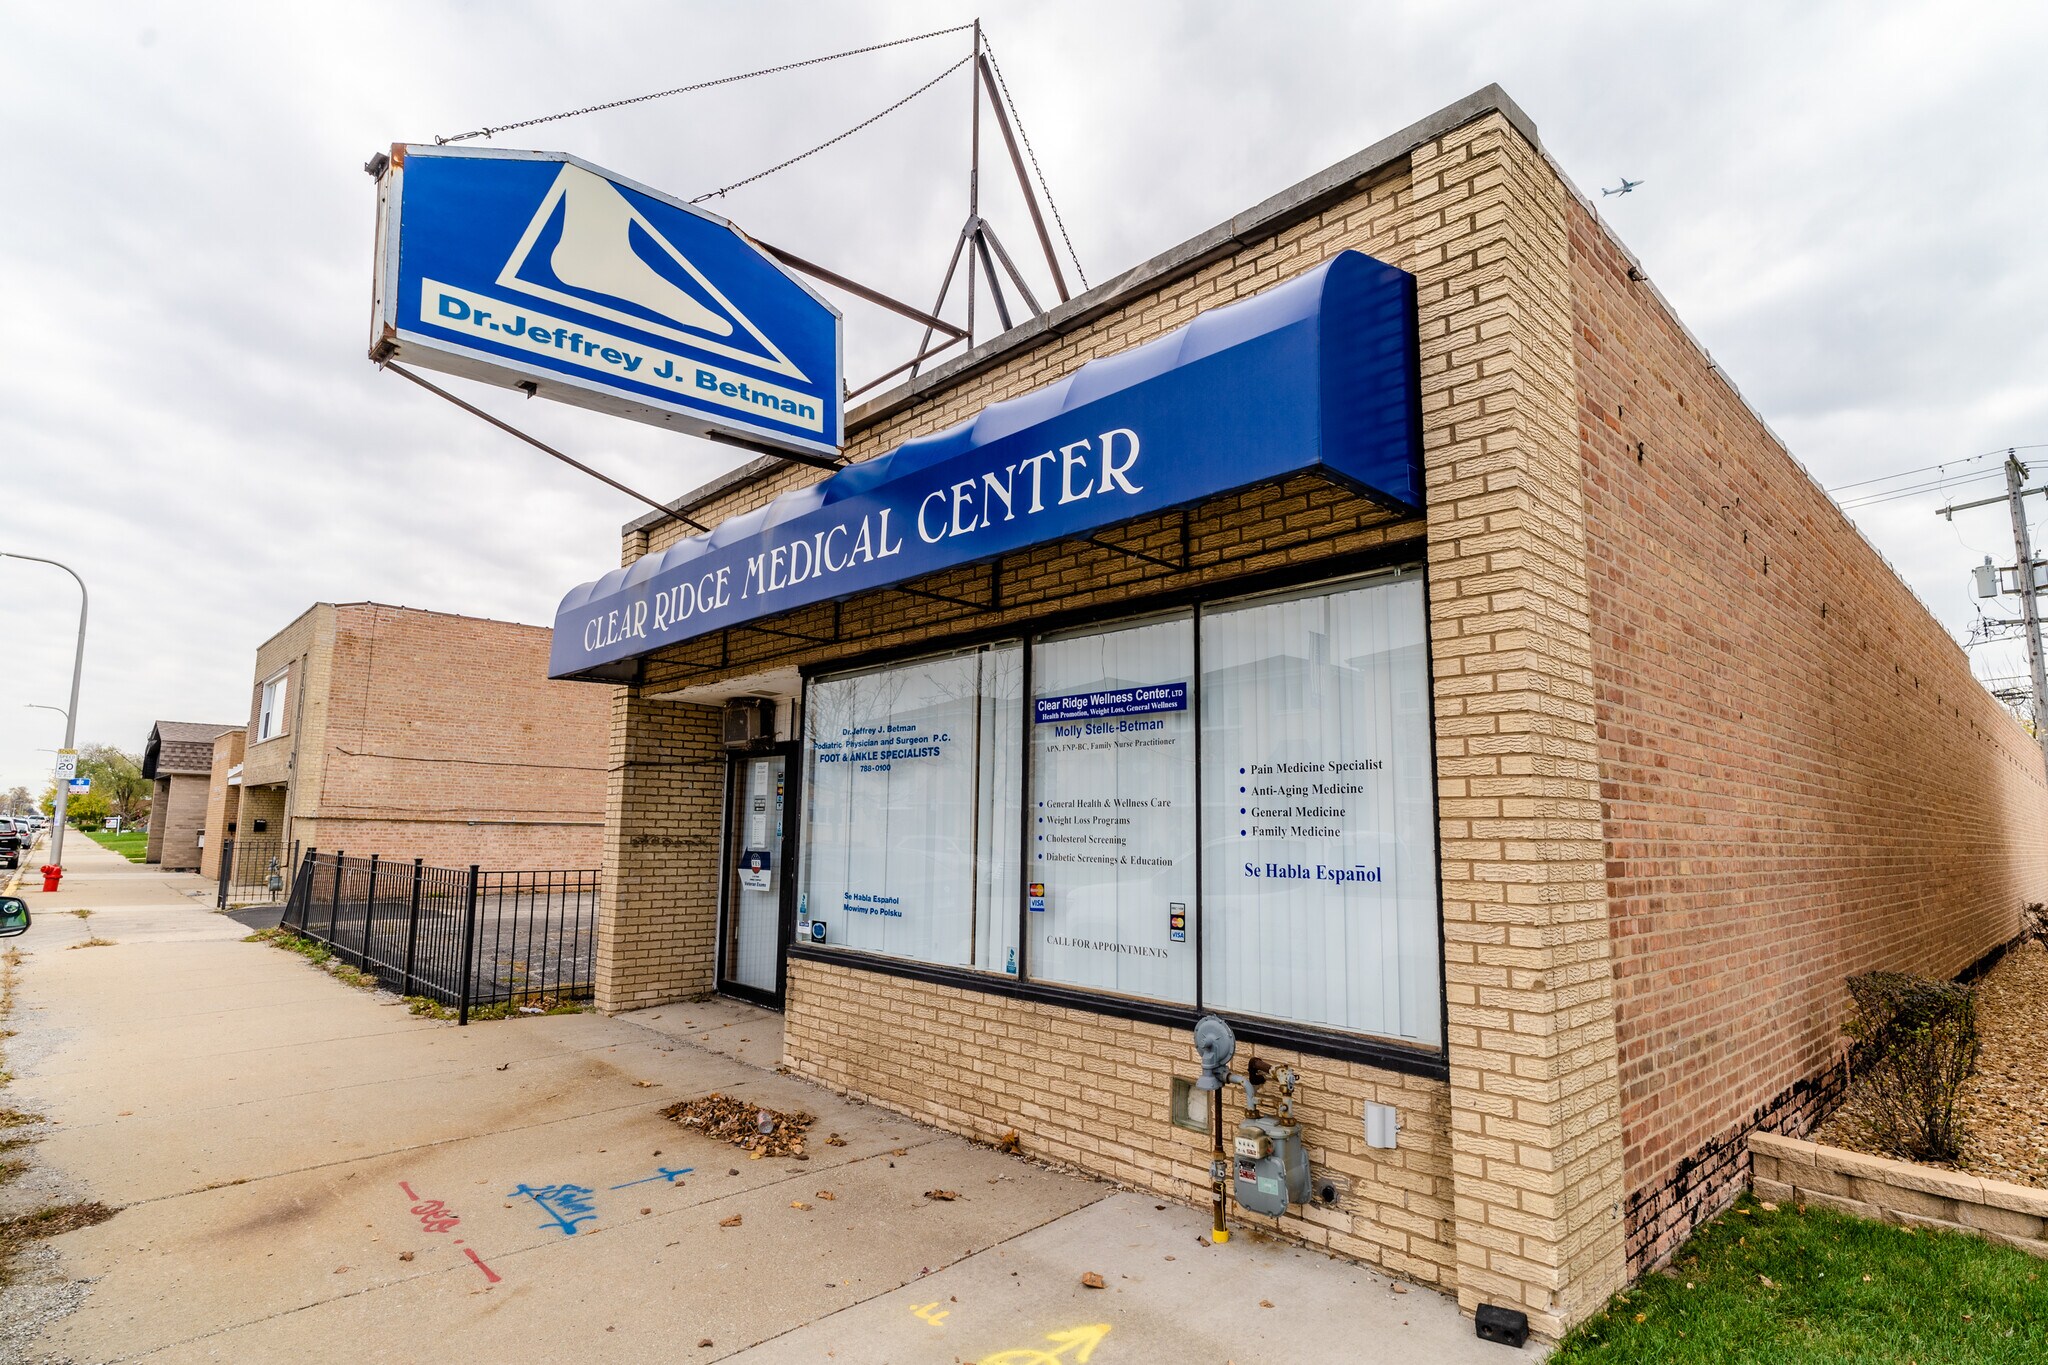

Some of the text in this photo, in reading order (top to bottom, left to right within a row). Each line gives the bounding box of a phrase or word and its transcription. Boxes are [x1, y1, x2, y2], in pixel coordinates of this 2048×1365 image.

[653, 359, 683, 382] J.
[695, 368, 816, 420] Betman
[584, 428, 1144, 652] CLEAR RIDGE MEDICAL CENTER
[1038, 700, 1061, 712] Clear
[1062, 697, 1088, 710] Ridge
[1089, 692, 1133, 706] Wellness
[1171, 689, 1183, 698] LTD
[1042, 700, 1178, 720] Health Promotion, Weight Loss, General Wellness
[878, 726, 885, 734] J.
[887, 724, 916, 733] Betman
[1055, 724, 1082, 739] Molly
[813, 733, 951, 751] Podiatric Physician and Surgeon P.C.
[1090, 741, 1112, 751] Family
[1114, 740, 1133, 748] Nurse
[1134, 738, 1176, 747] Practitioner
[819, 746, 940, 763] FOOT & ANKLE SPECIALISTS
[860, 764, 892, 773] 788-0100
[1250, 759, 1383, 775] Pain Medicine Specialist
[1251, 783, 1364, 798] Anti-Aging Medicine
[1046, 797, 1172, 809] General Health & Wellness Care
[1251, 806, 1346, 818] General Medicine
[1046, 815, 1131, 827] Weight Loss Programs
[1252, 825, 1341, 839] Family Medicine
[1046, 834, 1127, 846] Cholesterol Screening
[1046, 852, 1173, 867] Diabetic Screenings & Education
[1244, 862, 1382, 885] Se Habla Español
[844, 891, 900, 905] Se Habla Español
[1031, 899, 1044, 907] VISA
[843, 904, 903, 918] Mowimy Po Polsku
[1172, 931, 1184, 939] VISA
[1046, 935, 1169, 959] CALL FOR APPOINTMENTS
